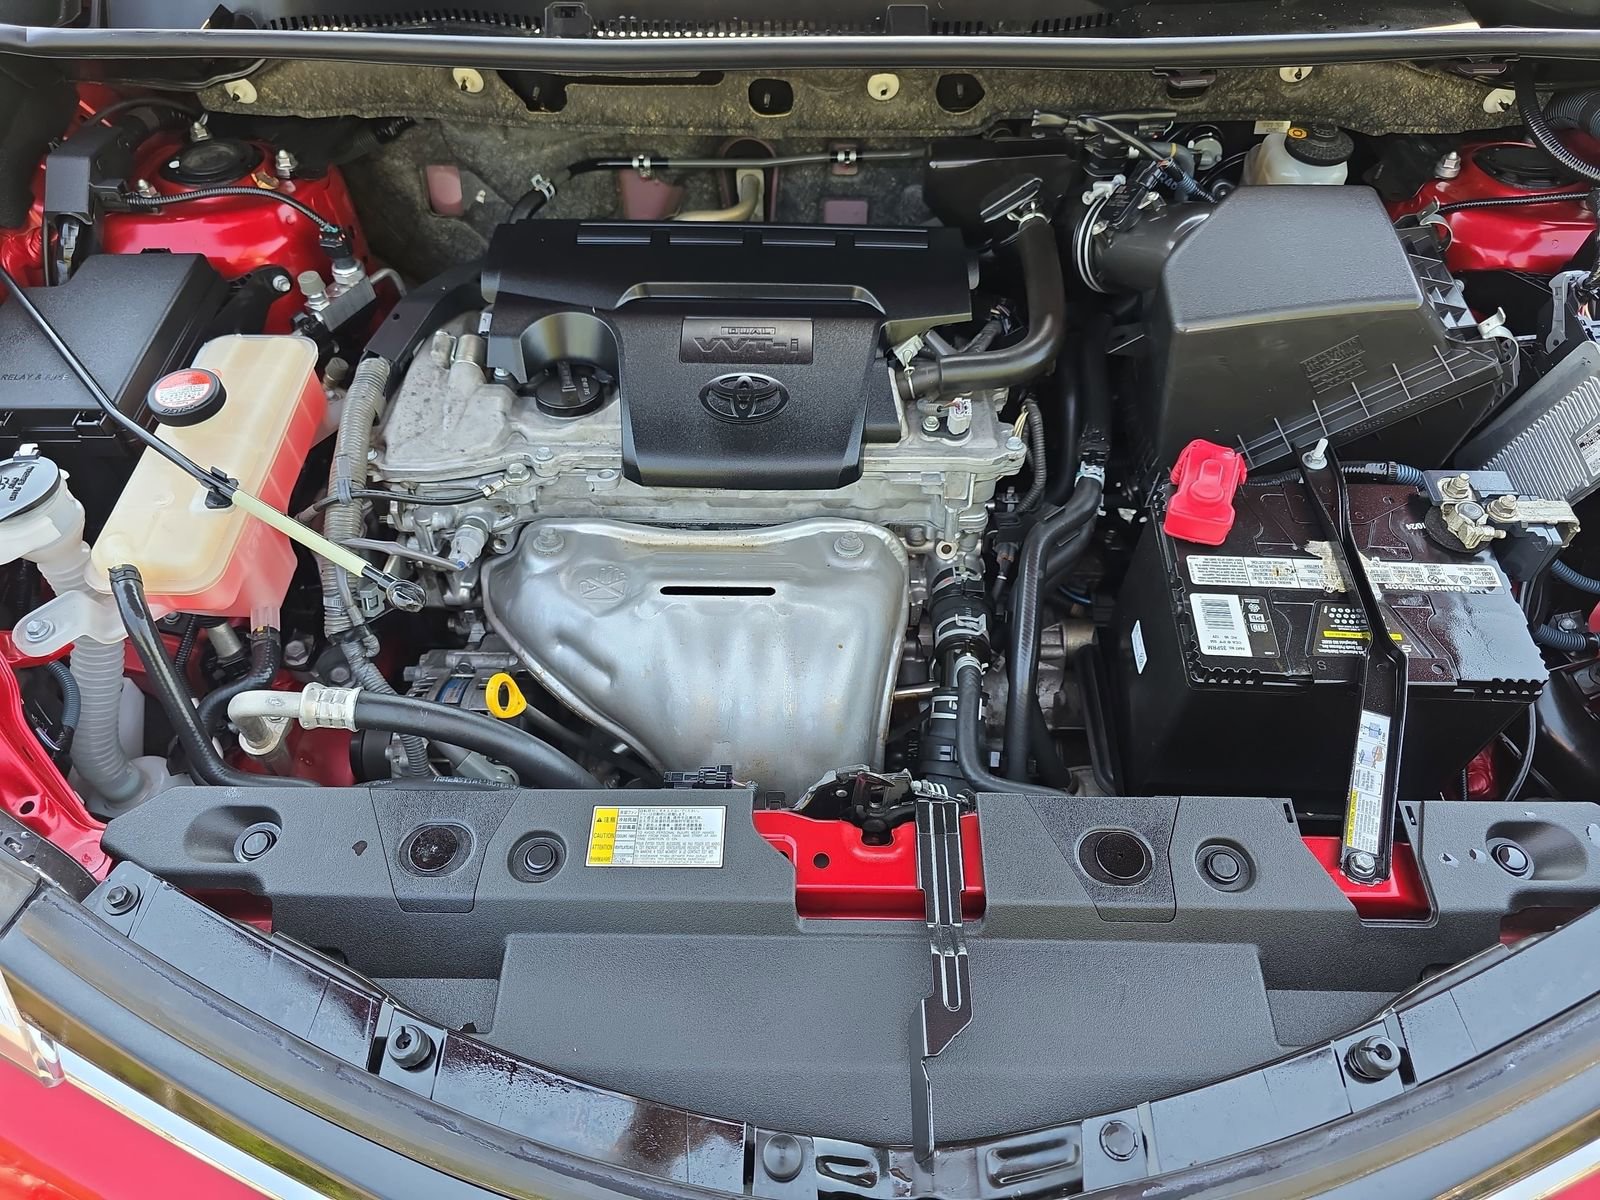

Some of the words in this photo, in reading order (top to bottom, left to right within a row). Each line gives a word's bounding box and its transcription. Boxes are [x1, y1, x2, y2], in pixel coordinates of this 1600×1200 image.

[725, 326, 774, 335] DUAL
[693, 337, 799, 353] VVT-i
[1, 373, 33, 381] RELAY
